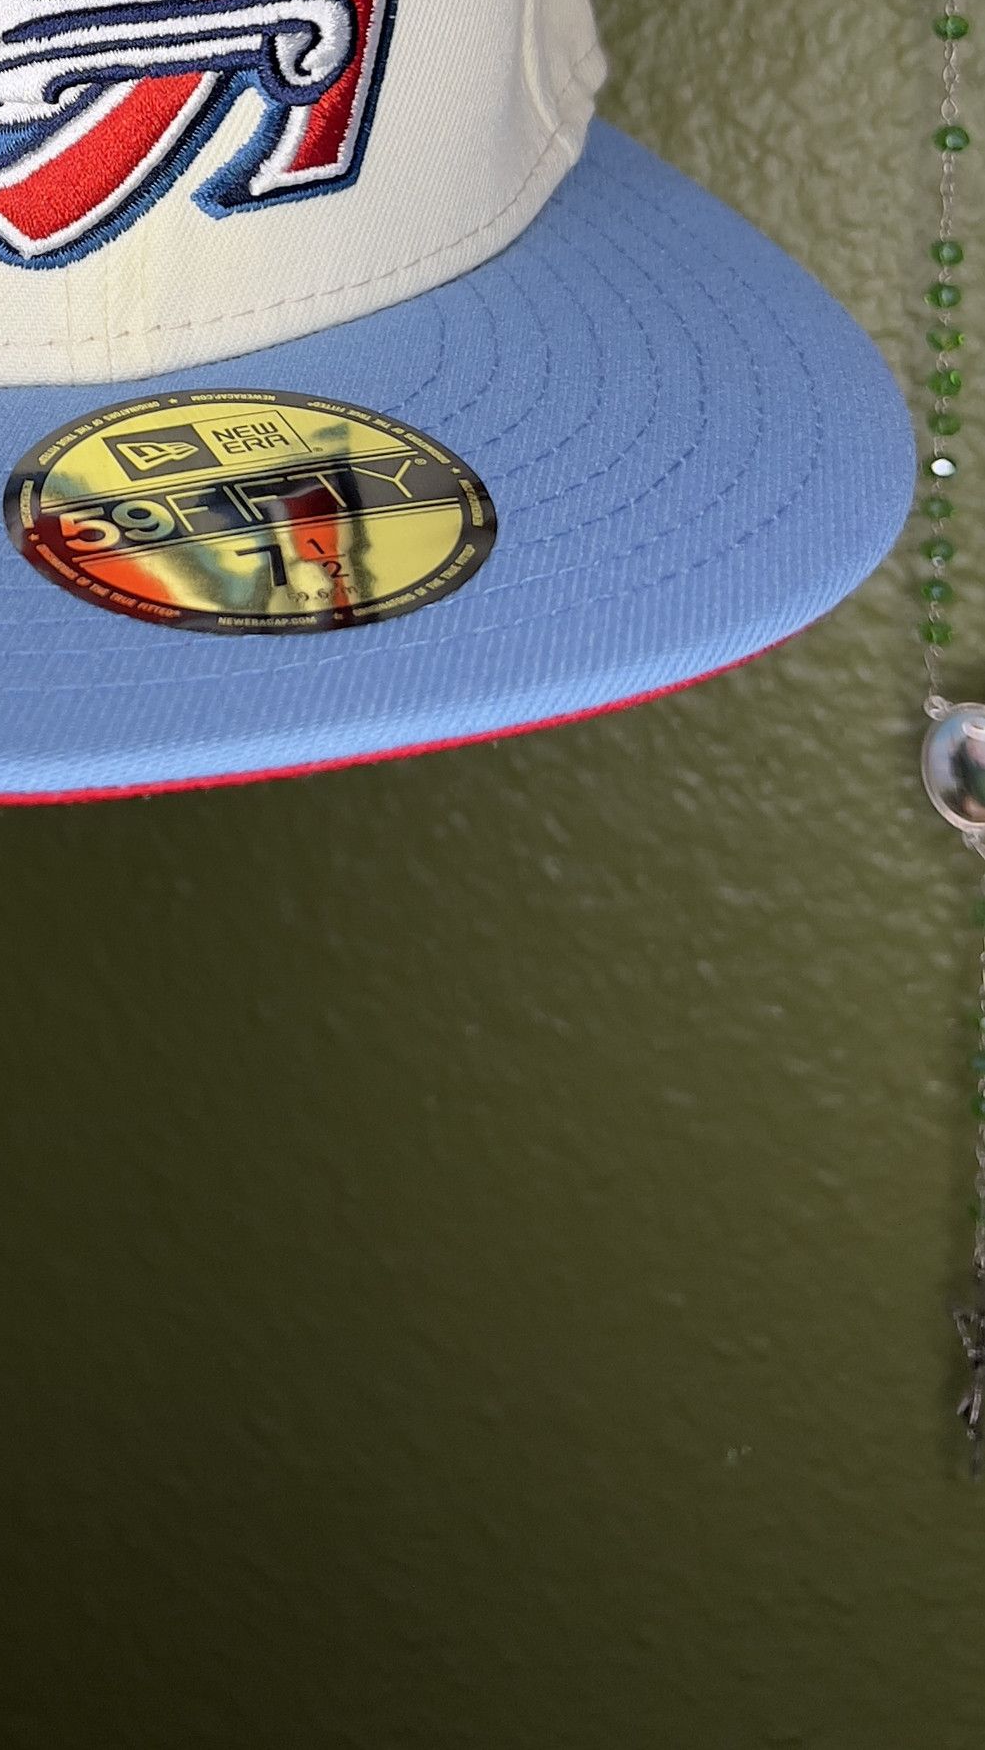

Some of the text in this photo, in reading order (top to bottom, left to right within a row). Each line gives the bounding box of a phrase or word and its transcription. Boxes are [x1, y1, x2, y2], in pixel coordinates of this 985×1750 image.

[211, 421, 279, 442] NEW
[222, 433, 290, 454] ERA
[236, 544, 288, 587] 7
[217, 616, 317, 627] NEWERACAP.COM
